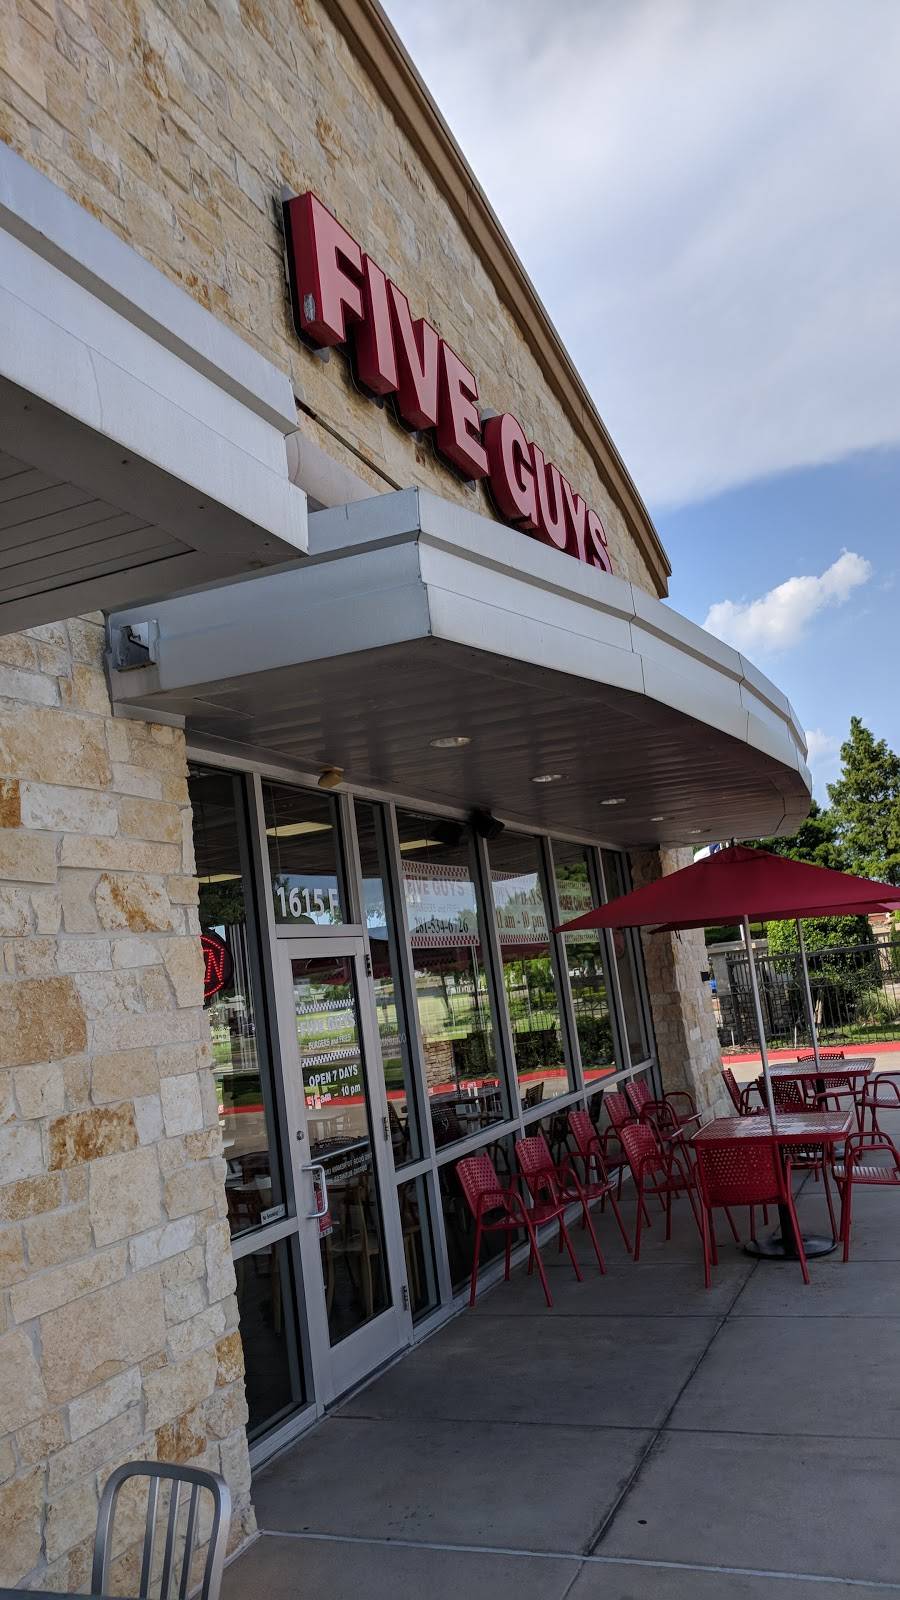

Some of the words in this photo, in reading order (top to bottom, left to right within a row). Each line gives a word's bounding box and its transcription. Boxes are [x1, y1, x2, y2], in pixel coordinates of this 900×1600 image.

[289, 191, 488, 481] FIVE
[486, 412, 613, 574] GUYS
[405, 874, 431, 896] FIVE
[432, 877, 465, 896] GUYS
[276, 886, 325, 917] 1615
[496, 911, 504, 928] 11
[504, 914, 516, 929] am
[521, 912, 530, 929] 10
[531, 915, 545, 932] pm
[308, 1073, 332, 1087] OPEN
[332, 1070, 338, 1081] 7
[338, 1064, 359, 1079] DAYS
[341, 1086, 350, 1097] 10
[350, 1083, 361, 1095] pm
